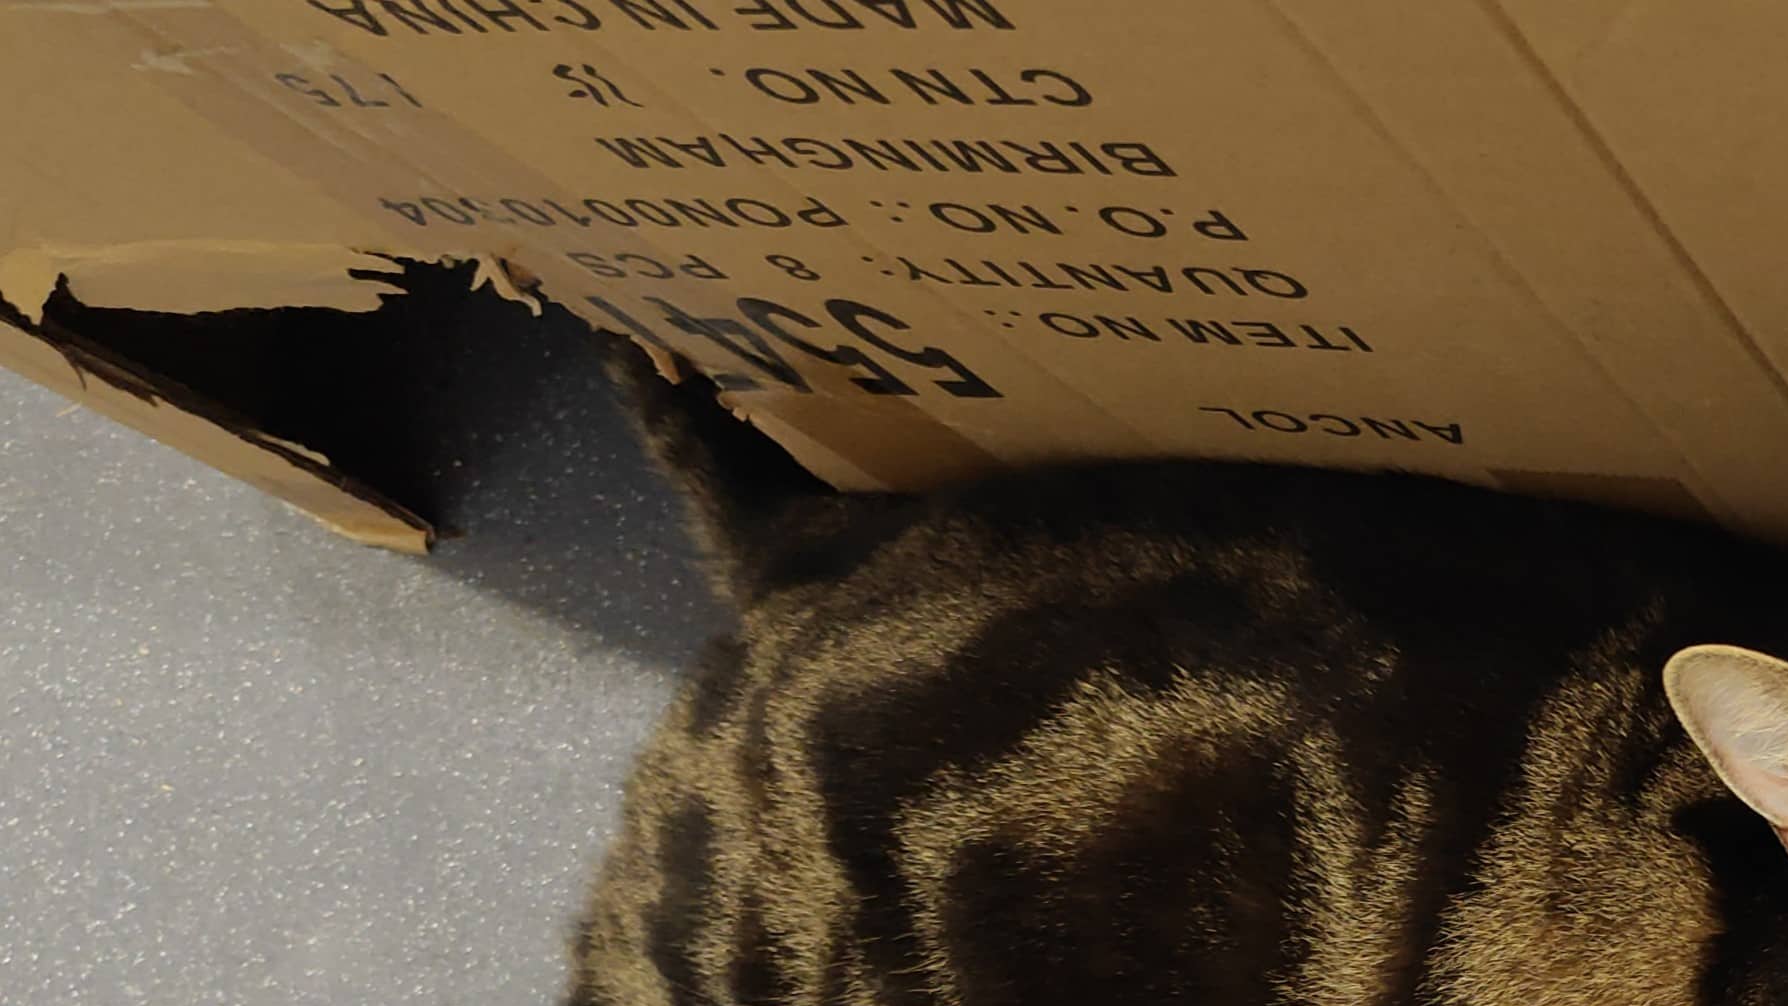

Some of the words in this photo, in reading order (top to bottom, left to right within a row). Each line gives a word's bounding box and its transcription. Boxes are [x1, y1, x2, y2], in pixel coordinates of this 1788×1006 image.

[307, 0, 601, 36] CHINA
[613, 0, 719, 31] IN
[737, 0, 1016, 30] MADE
[709, 68, 892, 105] NO.
[888, 69, 1093, 106] CTN
[594, 133, 1179, 176] BIRMINGHAM
[1066, 205, 1249, 241] P.O.
[565, 251, 730, 280] PCS
[764, 254, 822, 281] 8
[861, 255, 1309, 299] QUANTITY:
[983, 309, 1162, 342] NO.:
[1167, 317, 1374, 352] ITEM
[1198, 406, 1464, 444] ANCOL
